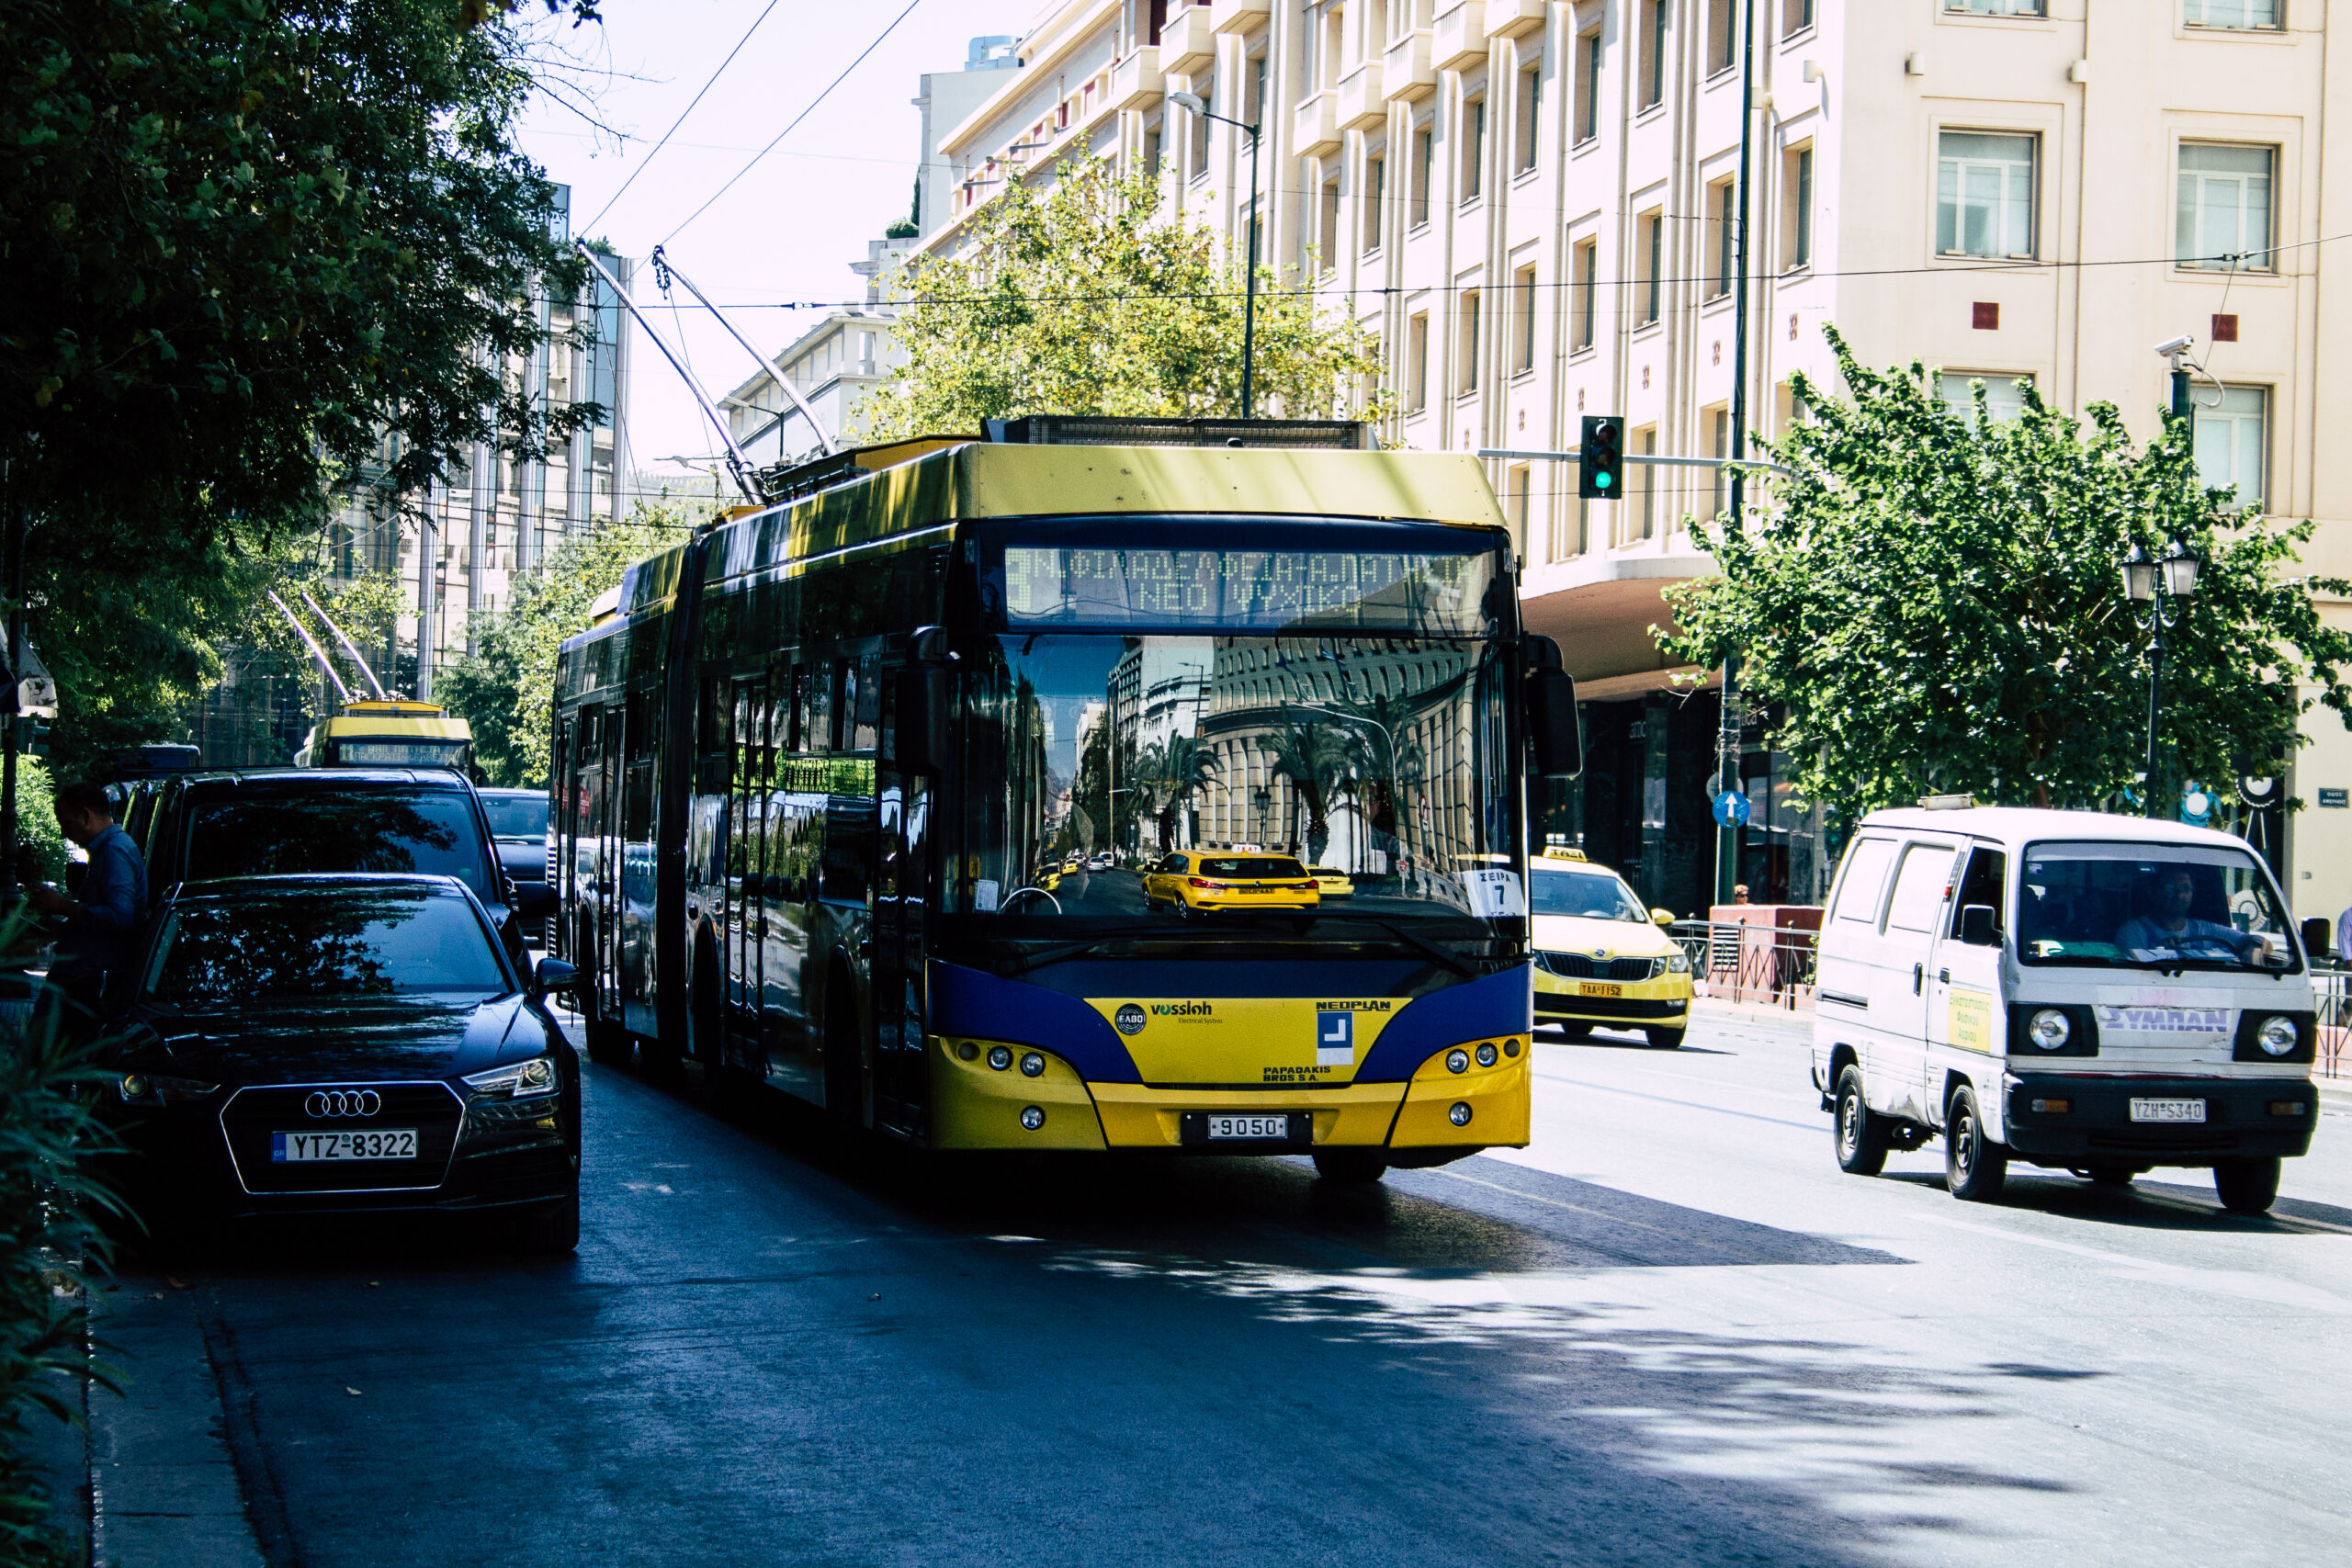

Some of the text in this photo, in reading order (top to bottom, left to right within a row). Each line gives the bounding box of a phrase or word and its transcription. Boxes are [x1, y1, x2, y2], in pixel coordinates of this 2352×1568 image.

[1141, 583, 1207, 611] ΝΕΟ
[1479, 872, 1511, 883] ΣΕΙΡΑ
[1494, 885, 1505, 905] 7
[1150, 1000, 1213, 1015] vossloh
[1316, 1001, 1391, 1011] NEOPLAN
[1263, 1066, 1331, 1074] PAPADAKIS
[1220, 1119, 1277, 1135] 9050
[273, 1149, 285, 1157] GR
[294, 1133, 414, 1159] YTZ-8322
